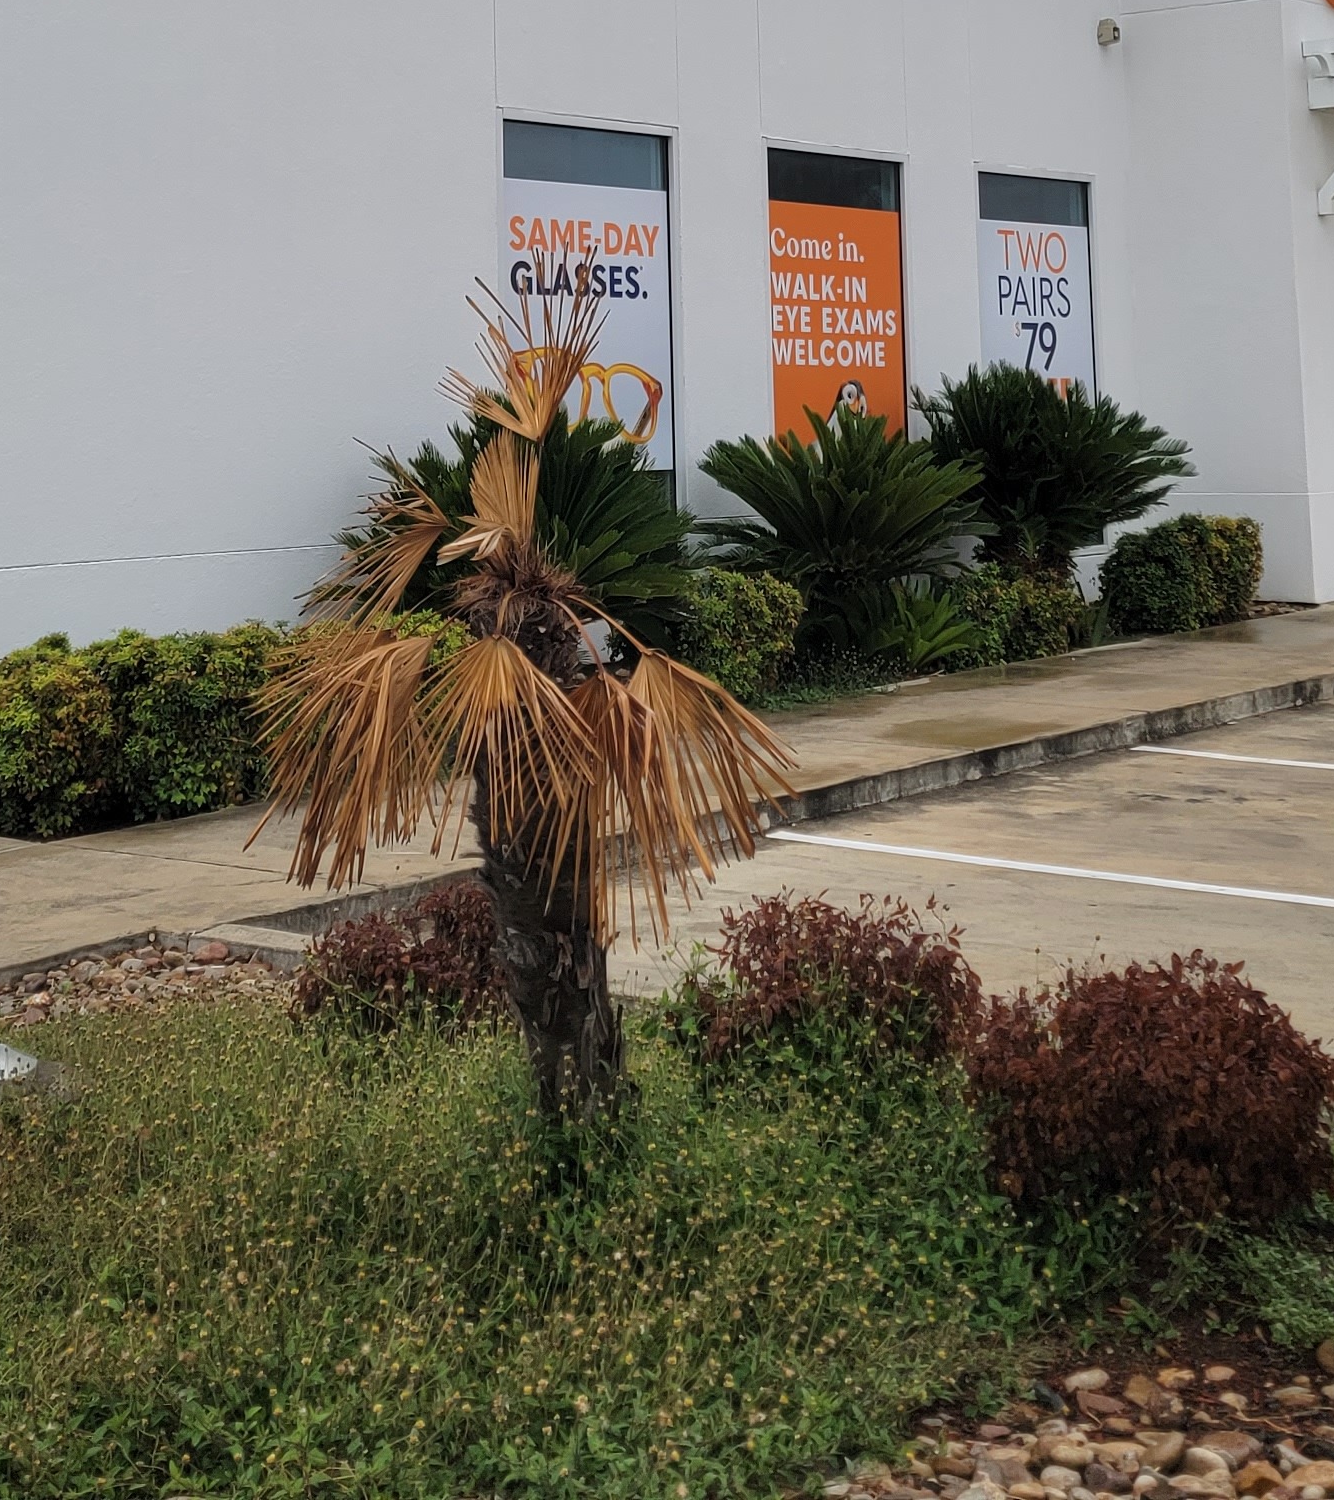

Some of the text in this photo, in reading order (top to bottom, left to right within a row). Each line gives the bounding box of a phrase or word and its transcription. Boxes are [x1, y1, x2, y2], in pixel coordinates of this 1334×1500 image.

[509, 215, 660, 258] SAME-DAY
[770, 227, 865, 263] Come in.
[996, 229, 1067, 274] TWO
[771, 271, 867, 303] WALK-IN
[998, 275, 1071, 318] PAIRS
[771, 304, 897, 337] EYE EXAMS
[772, 338, 886, 368] WELCOME
[1014, 321, 1057, 373] $79
